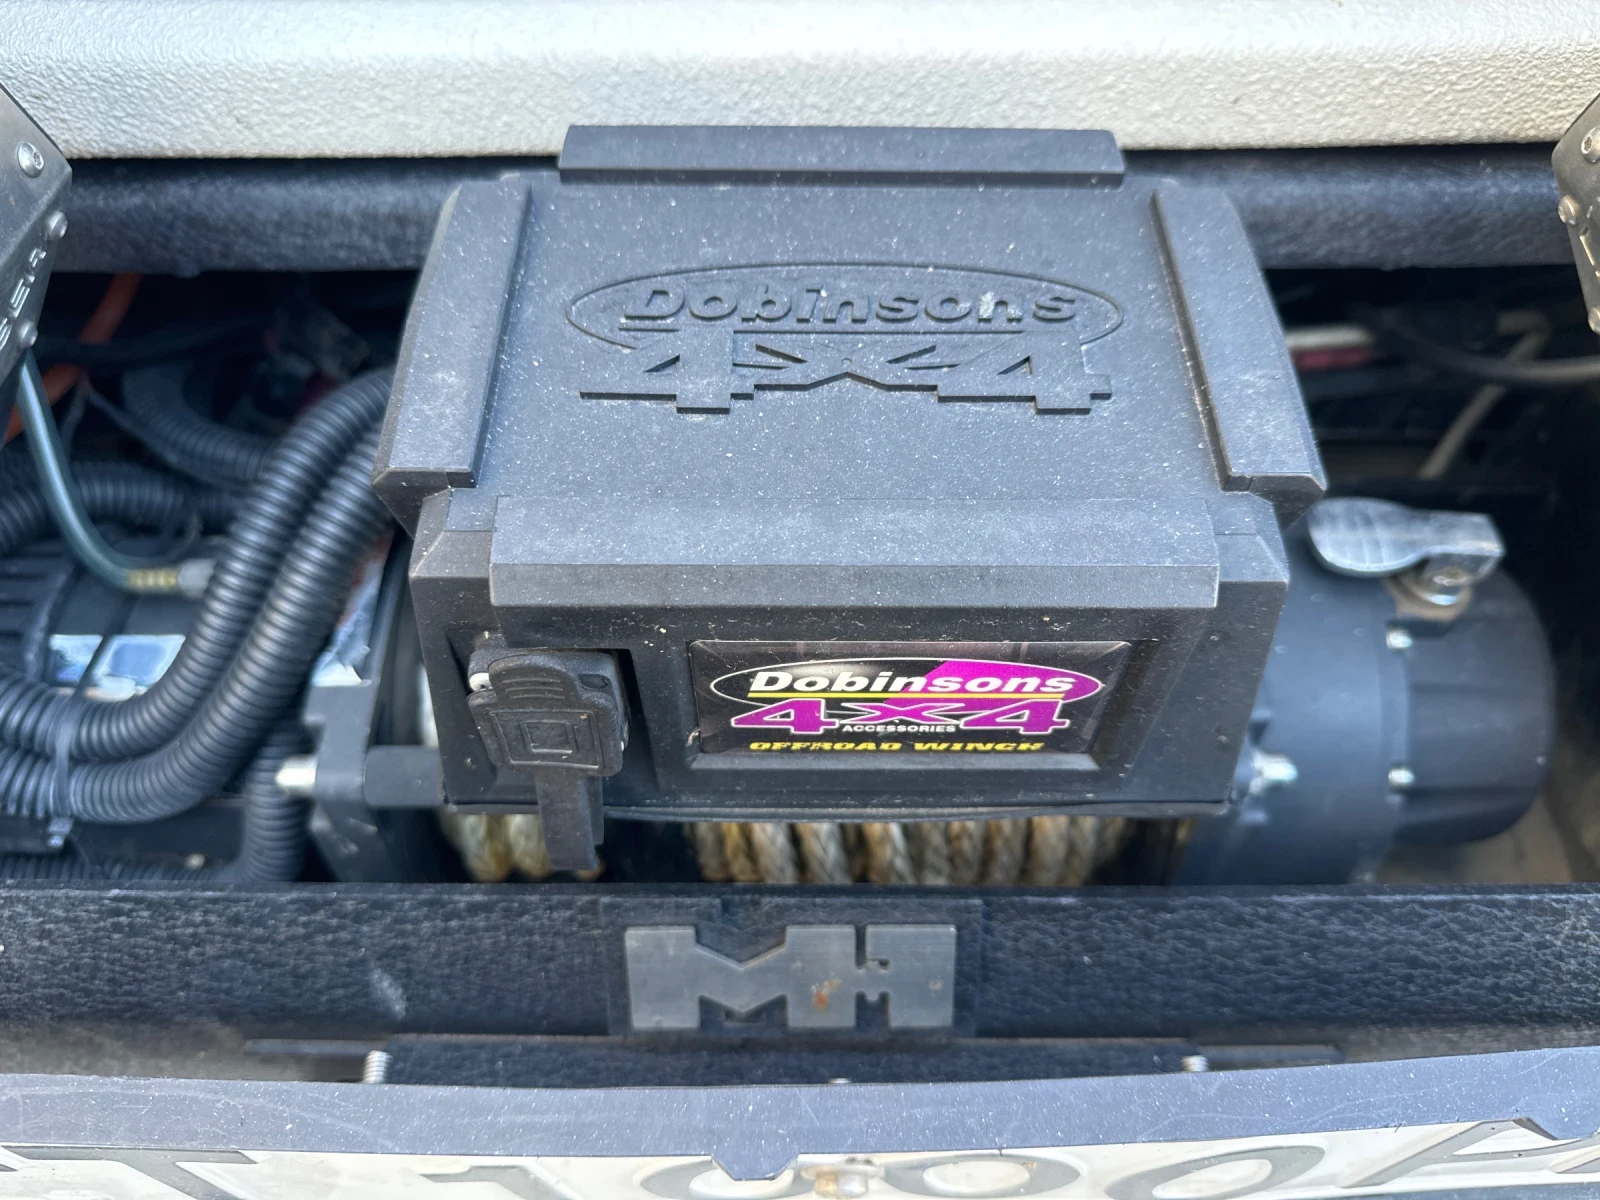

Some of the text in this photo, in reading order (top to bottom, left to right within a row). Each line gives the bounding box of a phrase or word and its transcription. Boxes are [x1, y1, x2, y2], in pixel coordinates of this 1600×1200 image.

[621, 285, 1076, 324] Dobinsons
[749, 670, 1076, 693] Dobinsons
[842, 723, 957, 734] ACCESSORIES
[748, 740, 1046, 752] OFFROAD WINCH
